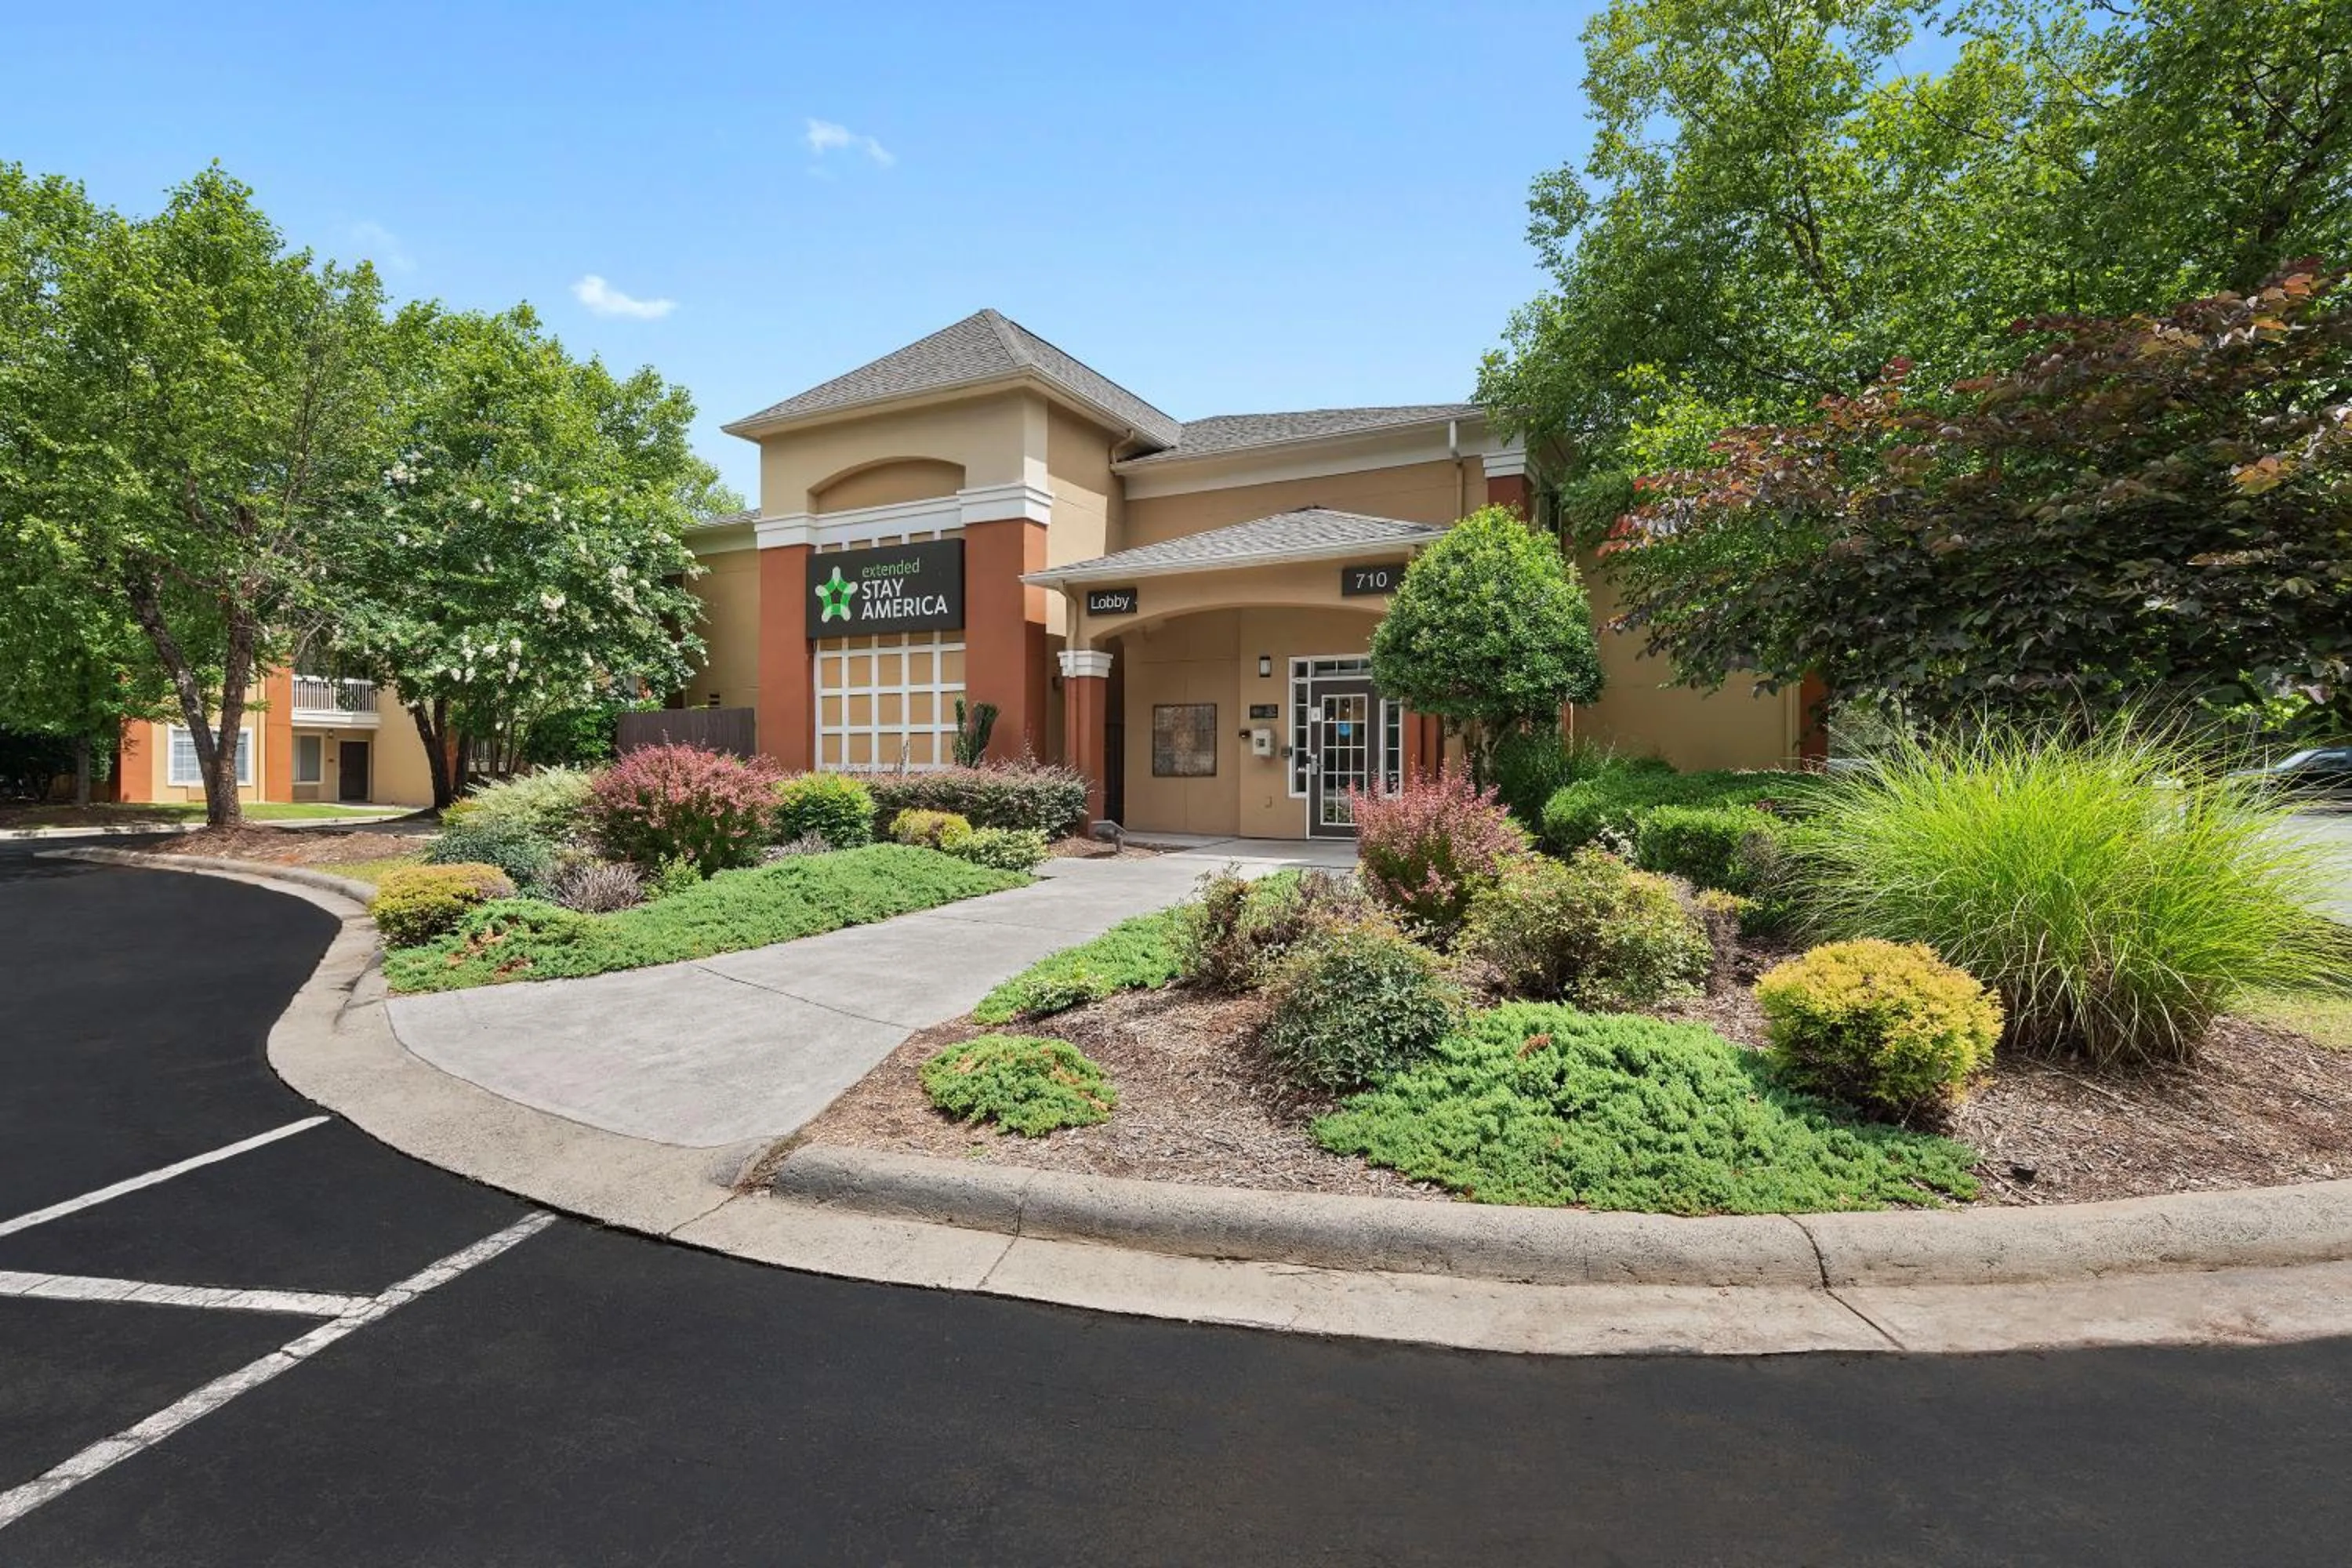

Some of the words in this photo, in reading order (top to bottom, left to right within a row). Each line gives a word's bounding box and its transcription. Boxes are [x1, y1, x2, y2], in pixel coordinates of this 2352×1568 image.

[862, 557, 920, 578] extended
[862, 578, 904, 600] STAY
[1356, 572, 1387, 589] 710
[861, 594, 948, 620] AMERICA
[1091, 593, 1130, 611] Lobby
